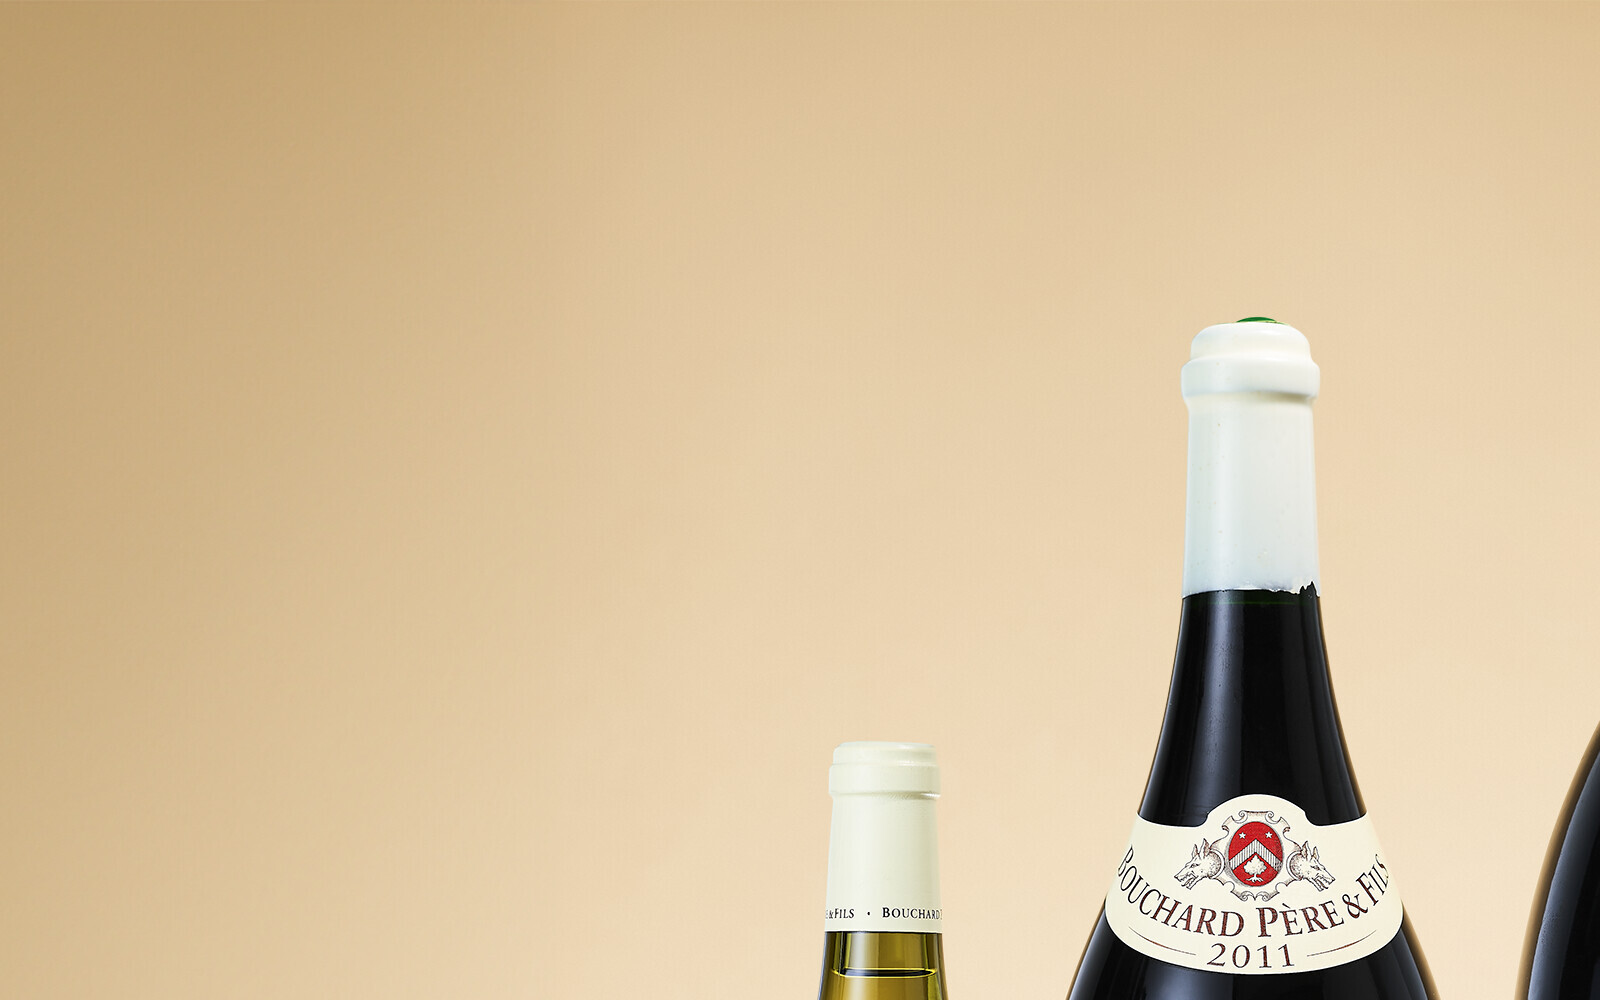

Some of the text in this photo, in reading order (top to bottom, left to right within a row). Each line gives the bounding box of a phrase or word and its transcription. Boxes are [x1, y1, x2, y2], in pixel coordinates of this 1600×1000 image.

[1117, 843, 1389, 938] BOUCHARD PÈRE & FILS
[882, 907, 939, 919] BOUCHARD
[1207, 943, 1295, 969] 2011
